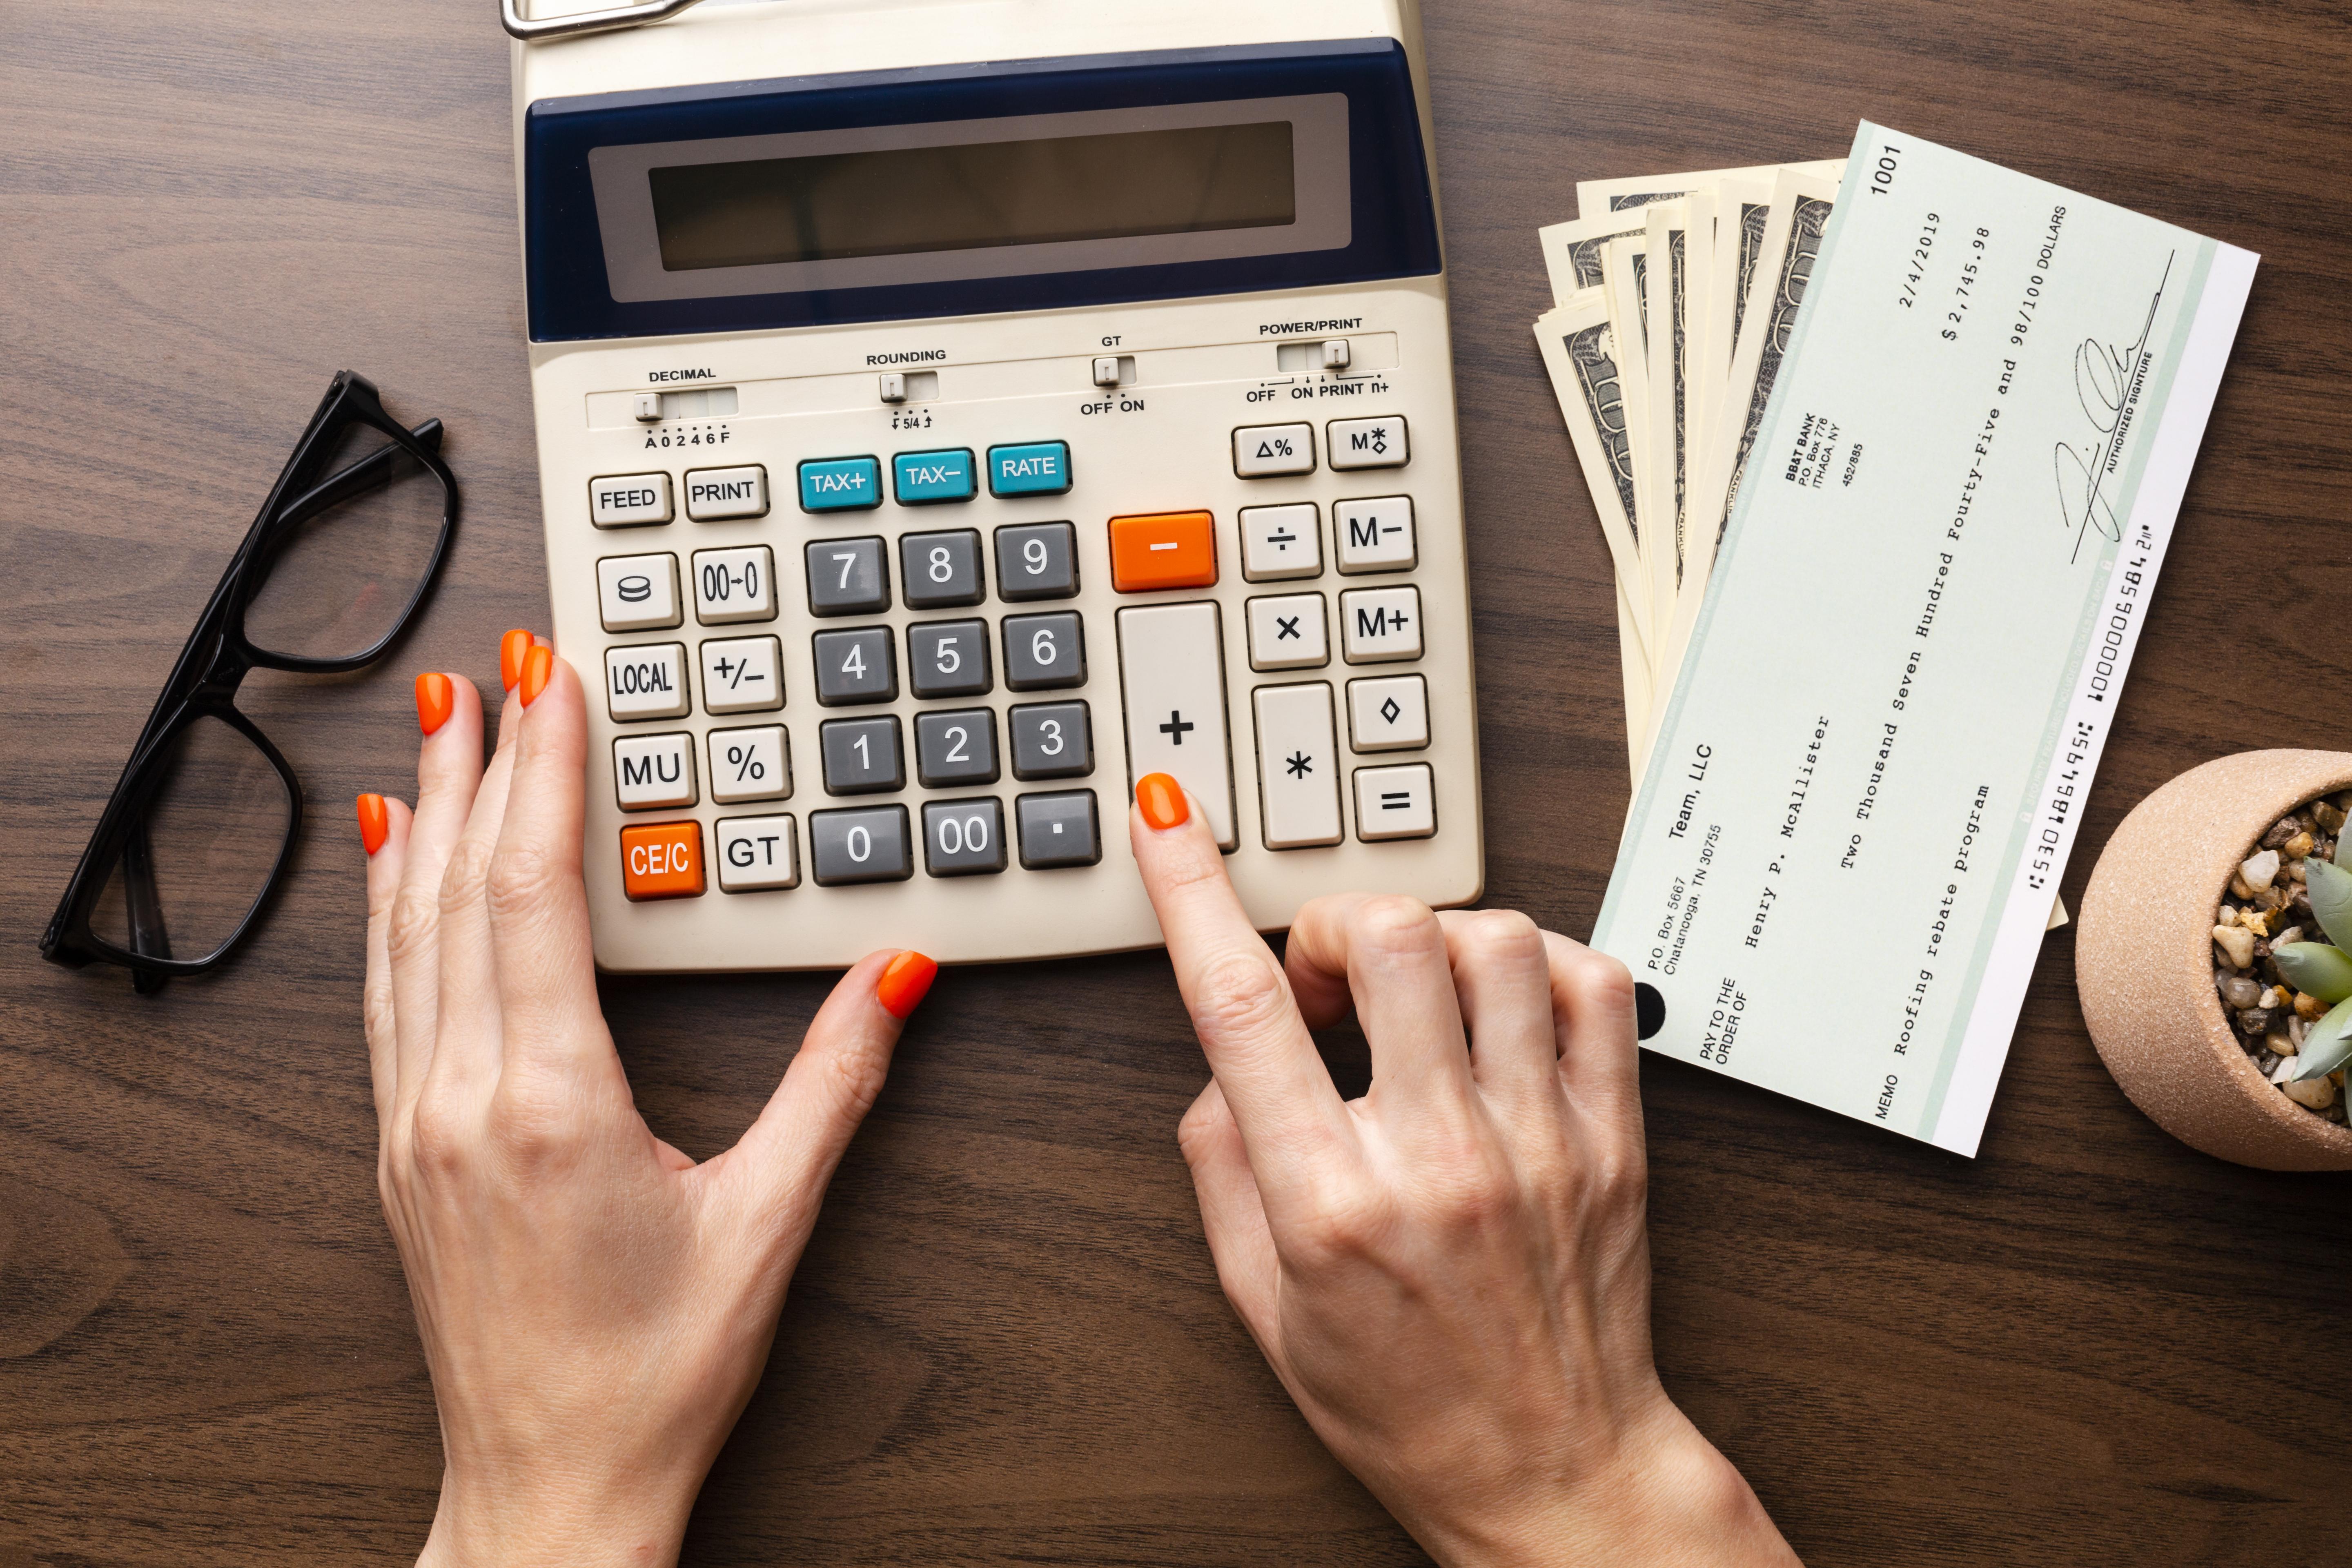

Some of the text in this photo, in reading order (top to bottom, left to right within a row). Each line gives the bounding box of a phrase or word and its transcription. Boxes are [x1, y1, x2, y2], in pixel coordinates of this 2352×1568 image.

[1871, 146, 1900, 194] 1001
[1900, 213, 1939, 307] 2/4/2019
[1102, 336, 1121, 346] GT
[1260, 318, 1362, 335] POWER/PRINT
[649, 369, 716, 381] DECIMAL
[867, 350, 946, 365] ROUNDING
[1081, 400, 1144, 415] OFF ON
[1247, 390, 1275, 402] OFF
[1292, 387, 1313, 399] ON
[1320, 383, 1363, 396] PRINT
[904, 418, 919, 429] 5/4
[2107, 352, 2152, 473] AUTHORIZED SIGNTURE
[645, 432, 729, 448] A 0 2 4 6 F
[1786, 413, 1815, 481] BB&T BANK
[1828, 423, 1839, 441] NY
[1002, 457, 1056, 477] RATE
[1798, 464, 1813, 486] P.O.
[1806, 441, 1820, 461] Box
[1843, 444, 1862, 486] 452/885
[601, 490, 655, 509] FEED
[693, 481, 753, 502] PRINT
[811, 473, 865, 492] TAX+
[1728, 470, 1742, 513] FRANKLIN
[1841, 206, 2066, 868] Two Thousand Seven Hundred Fourty-Five and 98/100 DOLLARS
[833, 553, 856, 588] 7
[930, 548, 952, 582] 8
[1024, 539, 1047, 574] 9
[2091, 573, 2108, 600] BACK
[1358, 608, 1408, 637] M+
[2085, 600, 2099, 619] ON
[1033, 630, 1056, 665] 6
[2073, 617, 2094, 656] DETAILS
[842, 644, 866, 679] 4
[937, 638, 960, 673] 5
[614, 663, 672, 694] LOCAL
[945, 727, 969, 762] 2
[1040, 720, 1063, 755] 3
[2040, 708, 2064, 759] FEATURES
[623, 753, 679, 785] MU
[728, 745, 764, 781] %
[854, 735, 869, 769] 1
[1669, 744, 1711, 837] Team, LLC
[2025, 759, 2048, 806] SECURITY
[848, 826, 870, 862] 0
[939, 816, 987, 853] 00
[1745, 716, 1828, 948] Henry P. McAllister
[631, 843, 688, 875] CE/C
[728, 837, 779, 867] GT
[1692, 869, 1706, 885] TN
[1700, 825, 1721, 865] 30755
[1648, 877, 1685, 970] P.O. Box 5667
[1875, 786, 1989, 1119] MEMO Roofing rebate program
[1700, 978, 1735, 1060] PAY TO THE
[1716, 991, 1746, 1065] ORDER OF
